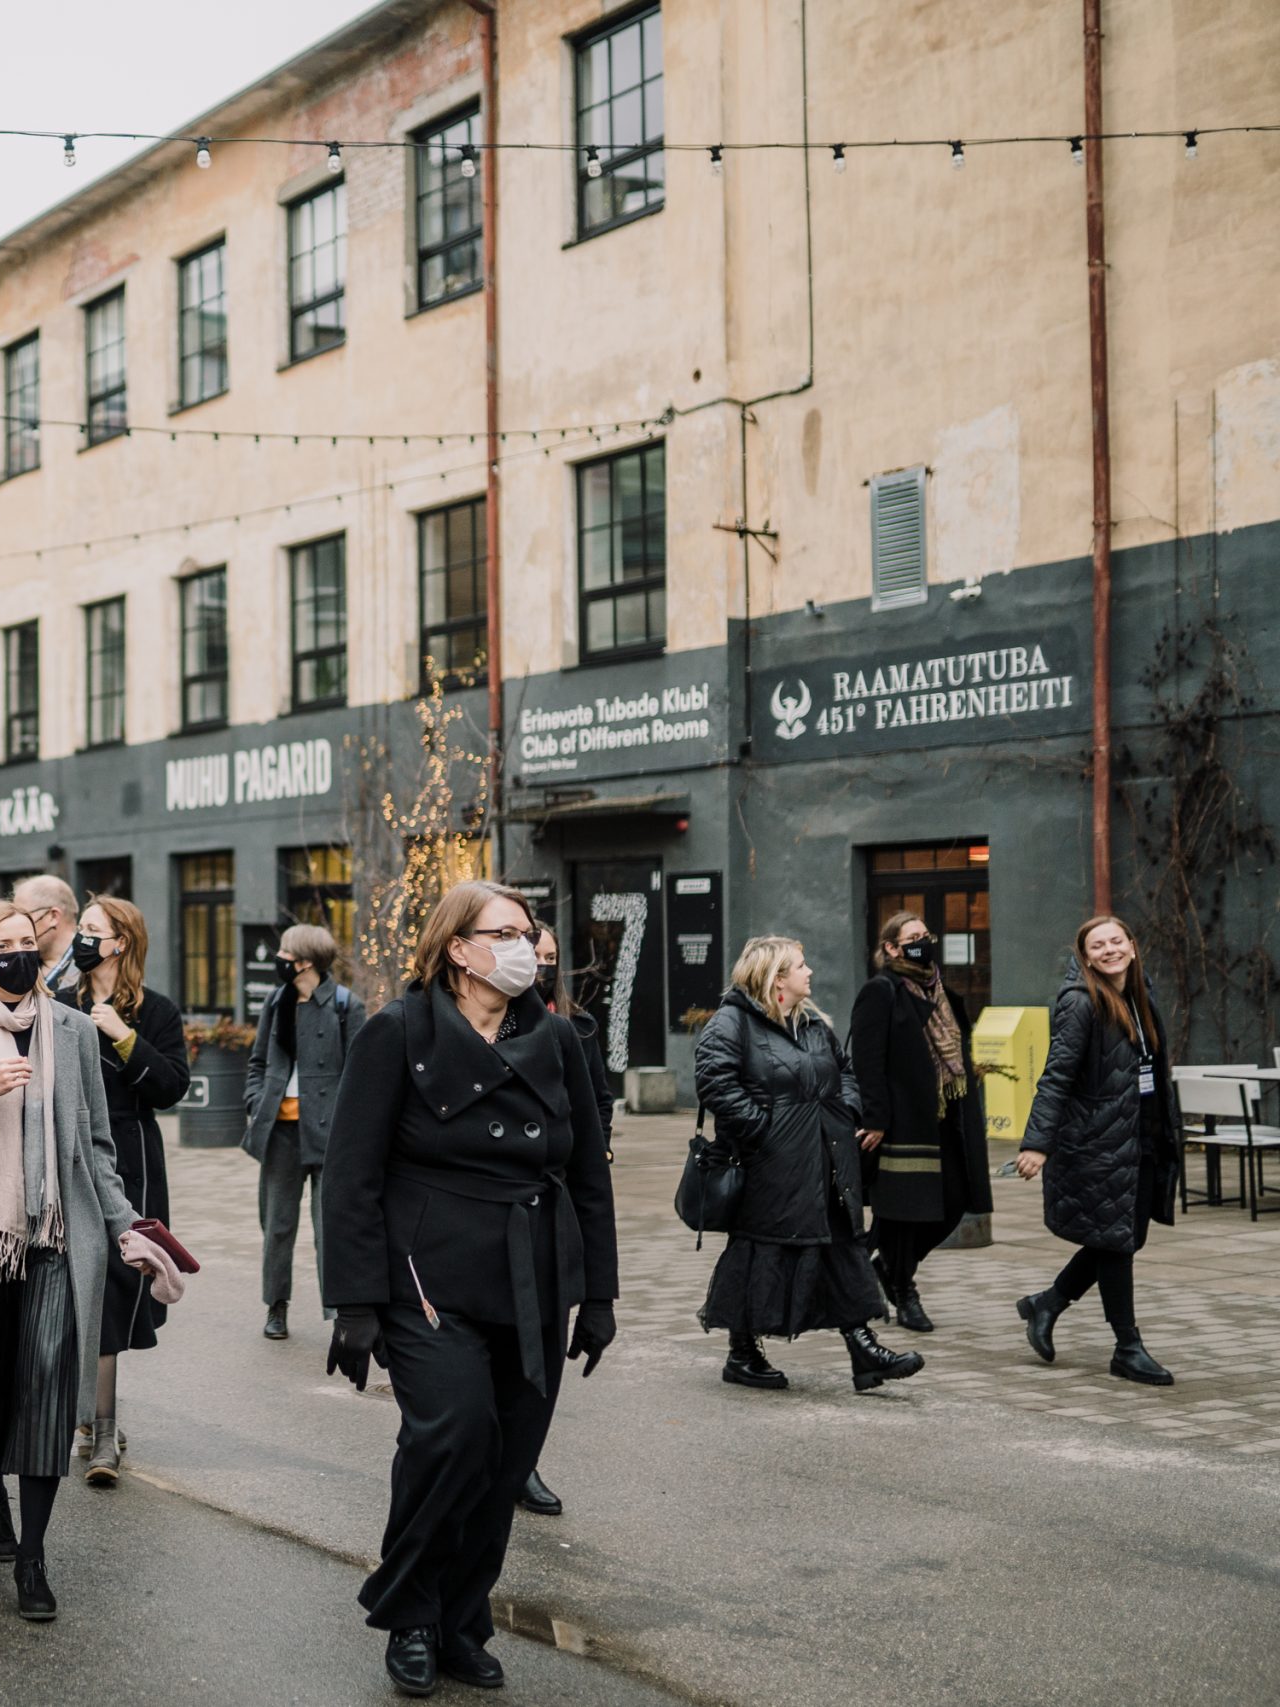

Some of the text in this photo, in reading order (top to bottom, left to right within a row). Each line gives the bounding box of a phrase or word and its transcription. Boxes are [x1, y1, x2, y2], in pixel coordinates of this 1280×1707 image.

[832, 644, 1050, 701] RAAMATUTUBA
[521, 683, 709, 734] Erinevate Tubade Klubi
[816, 675, 1073, 736] 451° FAHRENHEITI
[521, 719, 709, 759] Club of Different Rooms
[166, 738, 333, 812] MUHU PAGARID
[591, 892, 649, 1074] 7
